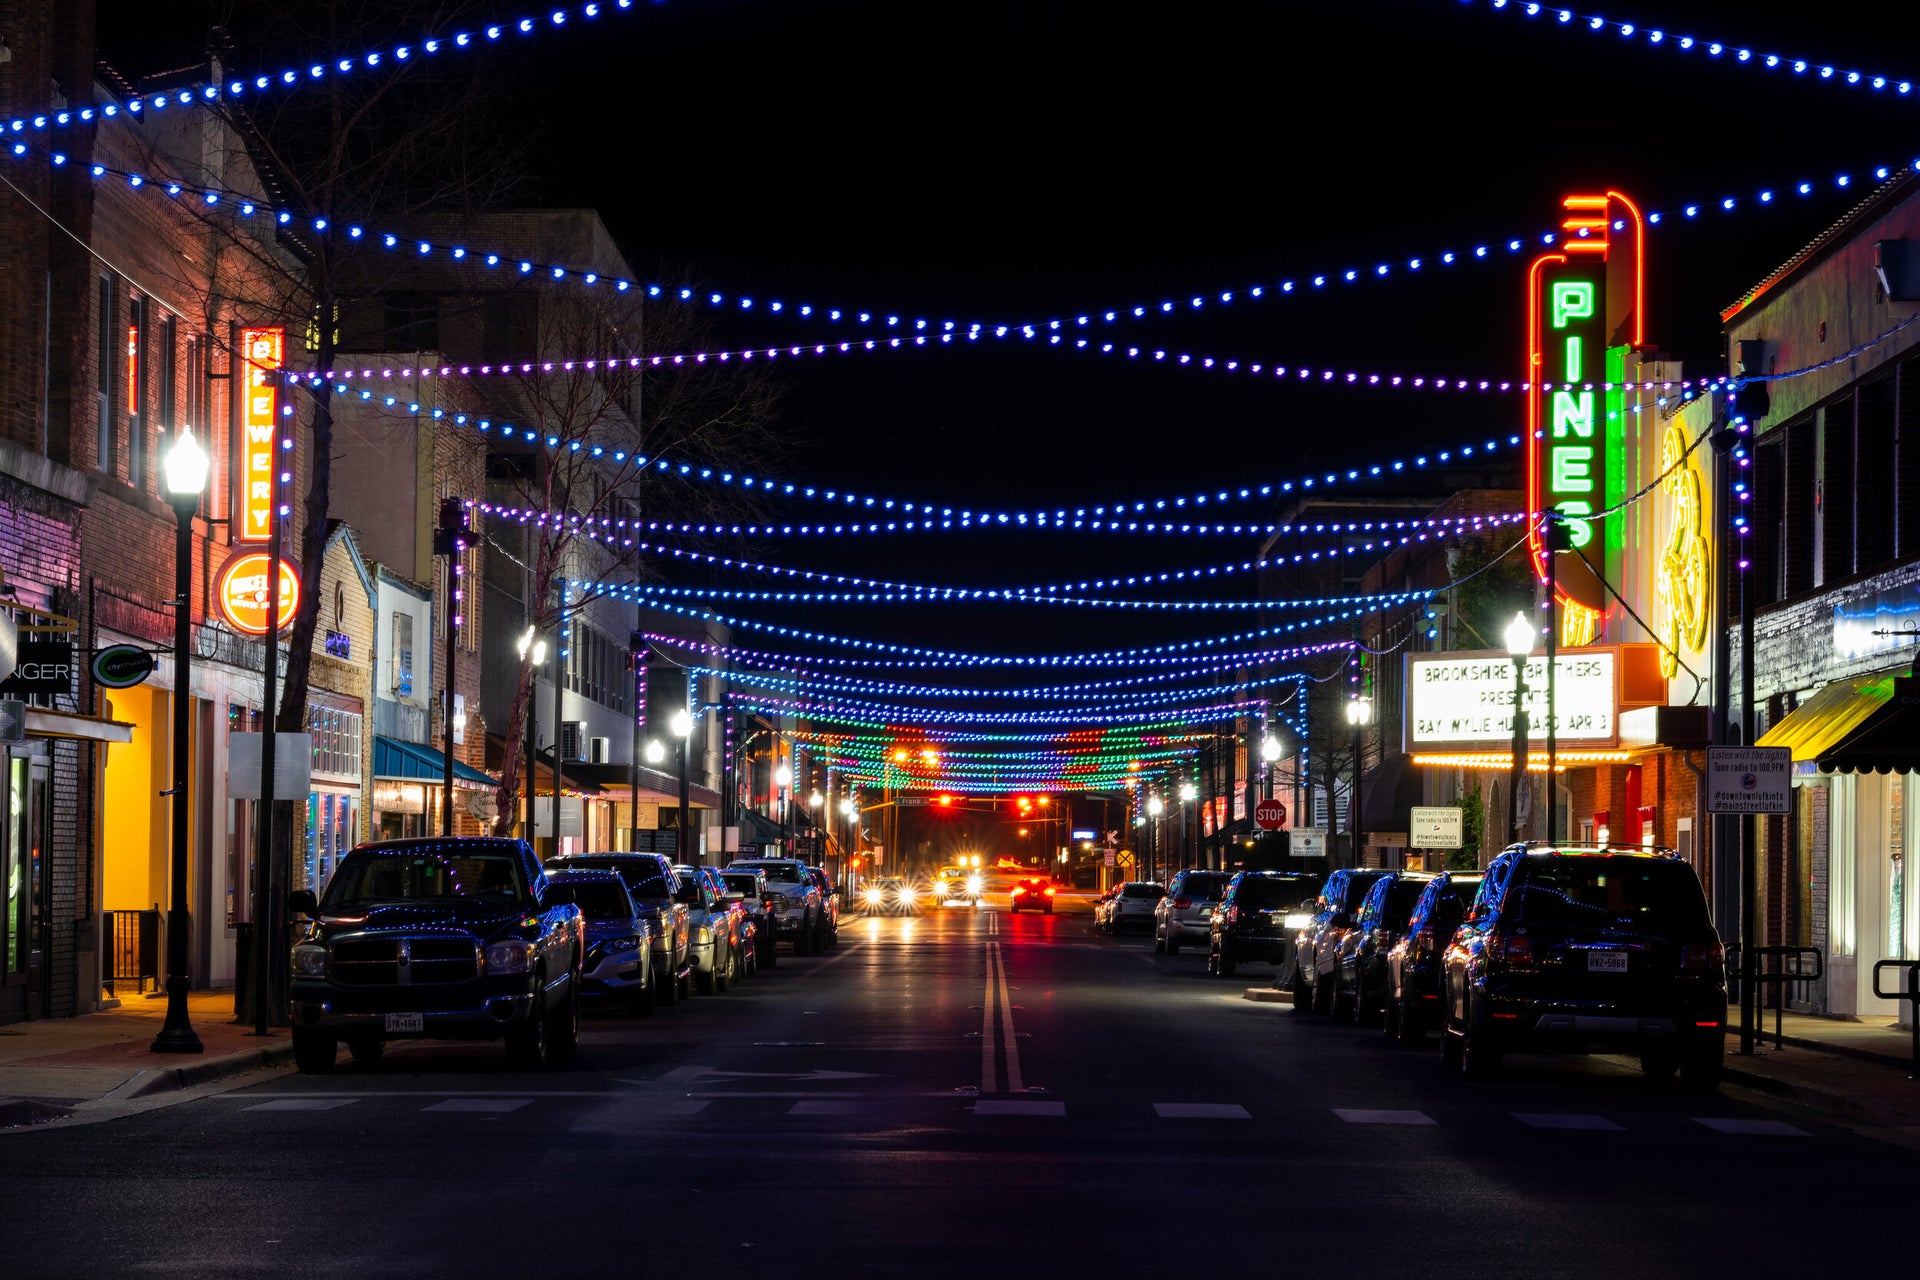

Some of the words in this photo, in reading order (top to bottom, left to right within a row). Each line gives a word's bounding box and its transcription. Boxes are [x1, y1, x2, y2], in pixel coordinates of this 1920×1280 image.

[1552, 281, 1595, 548] PINES
[1424, 664, 1509, 683] BROOKSHIRE
[1526, 661, 1602, 679] BRTHERS
[1479, 689, 1551, 706] PRESNTS
[1418, 718, 1442, 734] RAY
[1450, 717, 1491, 734] WYLIE
[1568, 714, 1593, 731] APR
[1711, 750, 1734, 760] Listen
[1734, 750, 1749, 760] with
[1751, 750, 1763, 760] the
[1765, 750, 1788, 763] lights
[1714, 762, 1729, 772] Tune
[1731, 762, 1748, 772] radio
[1750, 763, 1757, 772] to
[1759, 762, 1784, 773] 100.9FM
[1257, 808, 1285, 821] STOP
